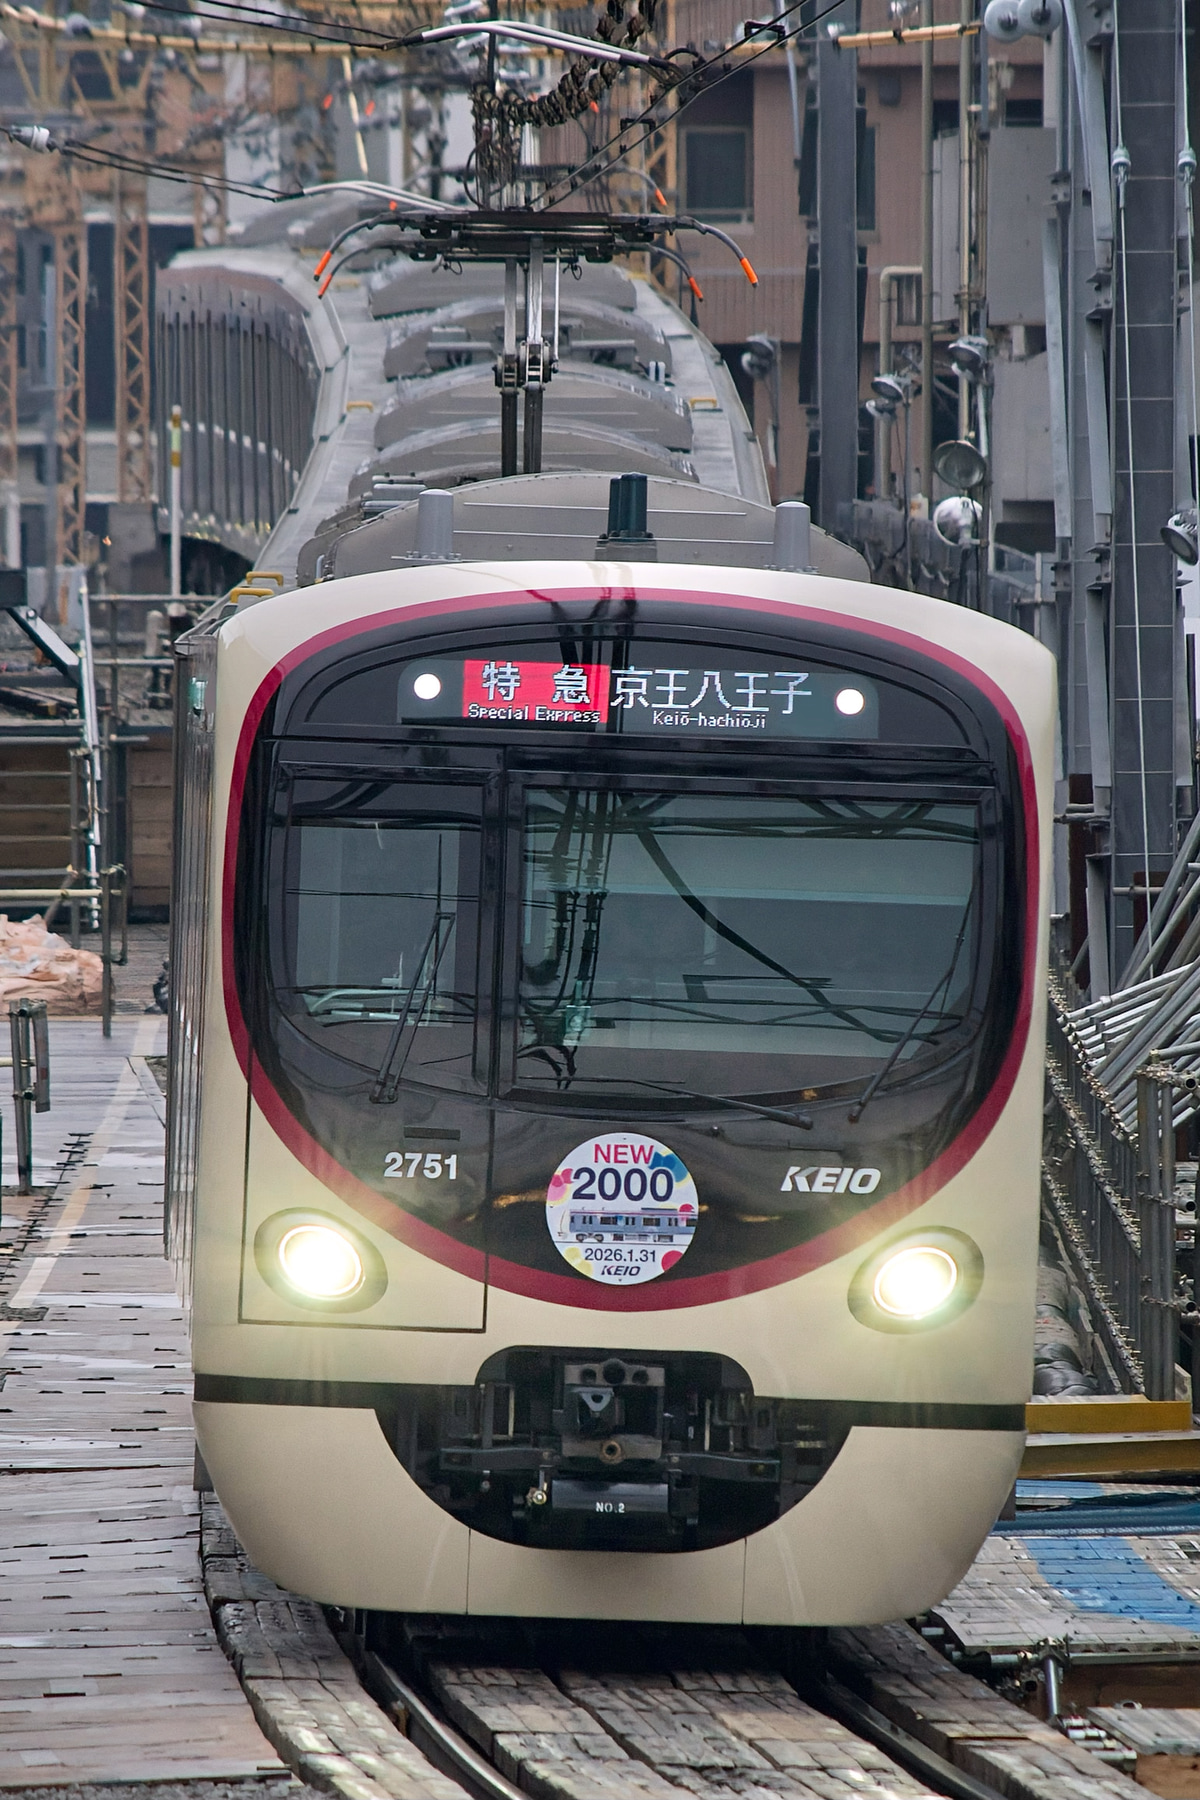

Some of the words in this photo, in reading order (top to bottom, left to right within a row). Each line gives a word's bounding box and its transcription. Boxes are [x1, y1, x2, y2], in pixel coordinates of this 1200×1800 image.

[610, 666, 812, 714] 京王八王子
[468, 703, 529, 721] Special
[535, 705, 601, 723] Express
[383, 1151, 457, 1180] 2751
[594, 1143, 654, 1165] NEW
[572, 1167, 674, 1202] 2000
[780, 1166, 881, 1195] KEIO
[584, 1247, 656, 1263] 2026.1.31
[601, 1265, 641, 1276] KEIO
